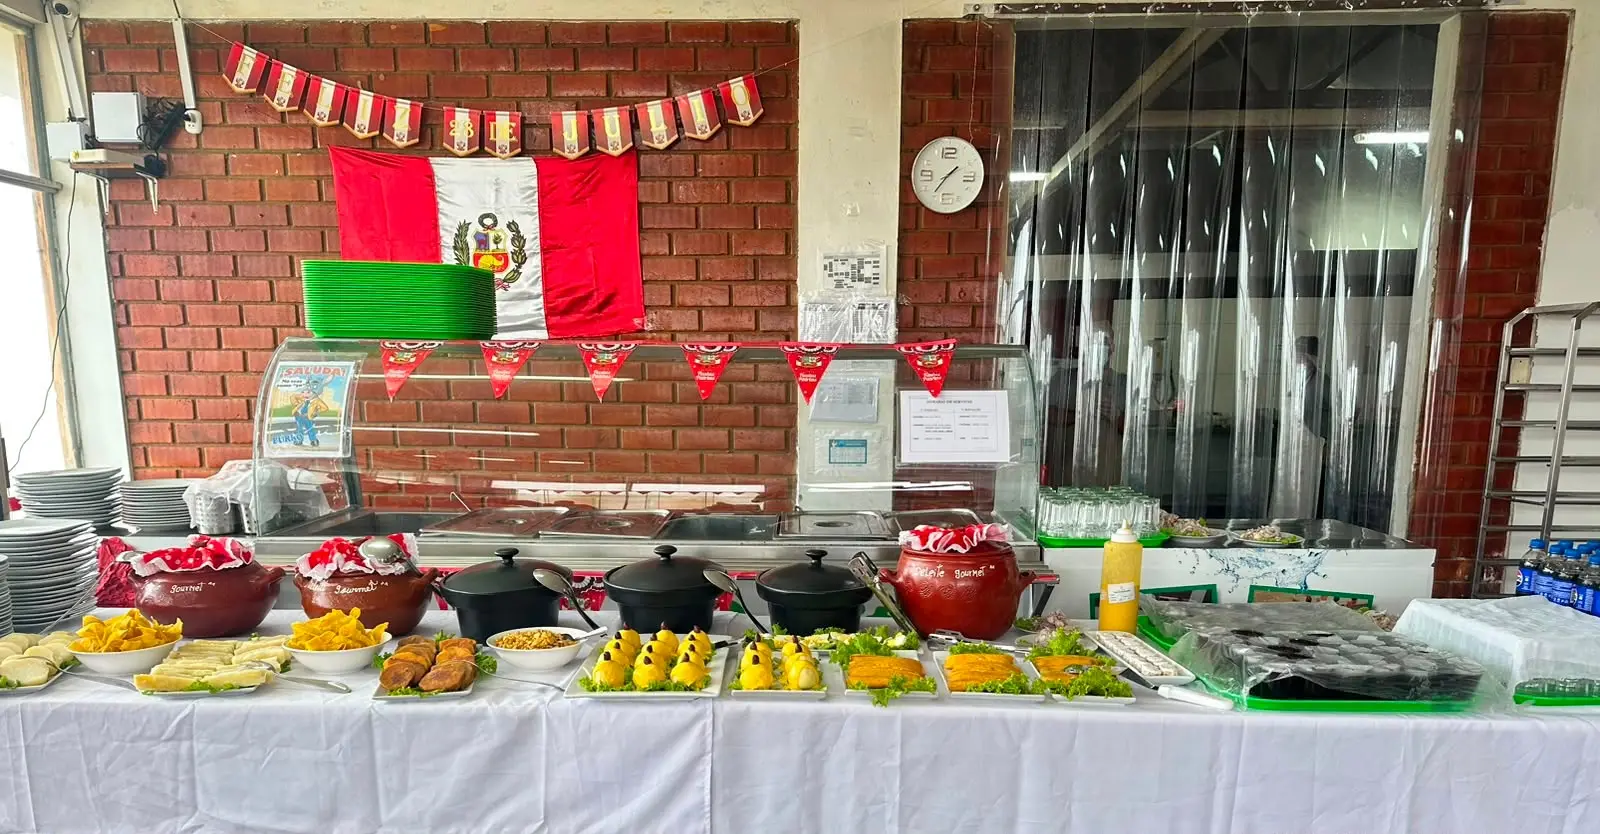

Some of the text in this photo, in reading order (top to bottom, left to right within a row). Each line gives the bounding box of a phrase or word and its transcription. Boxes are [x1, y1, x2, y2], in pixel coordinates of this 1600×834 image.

[448, 119, 475, 139] 28
[488, 121, 518, 142] DE
[941, 147, 958, 160] 12
[919, 169, 933, 182] 9
[962, 171, 976, 182] 3
[940, 192, 954, 205] 6
